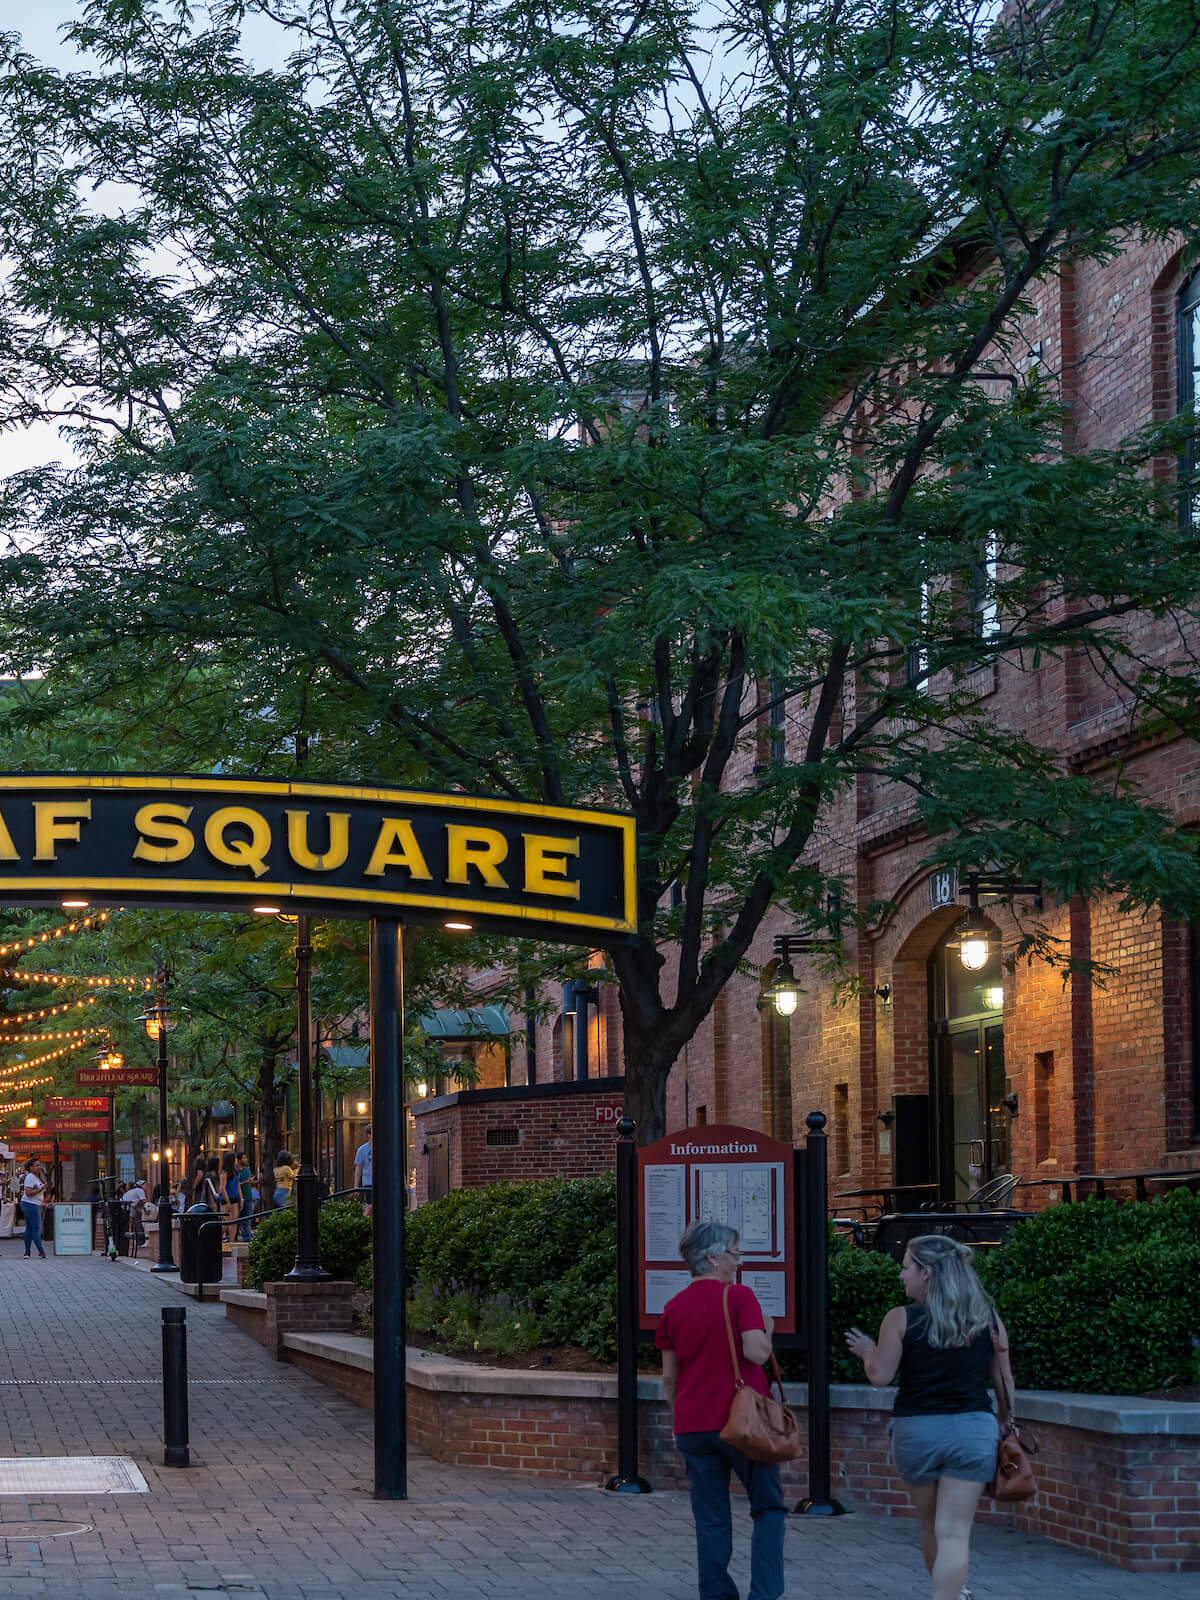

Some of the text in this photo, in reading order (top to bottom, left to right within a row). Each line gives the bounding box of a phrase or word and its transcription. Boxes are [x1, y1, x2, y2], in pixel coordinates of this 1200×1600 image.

[131, 801, 582, 901] SQUARE
[936, 873, 950, 902] 18
[79, 1071, 154, 1082] BRIGHTLEAF SQUARE
[595, 1106, 624, 1121] FDC
[669, 1140, 758, 1156] Information
